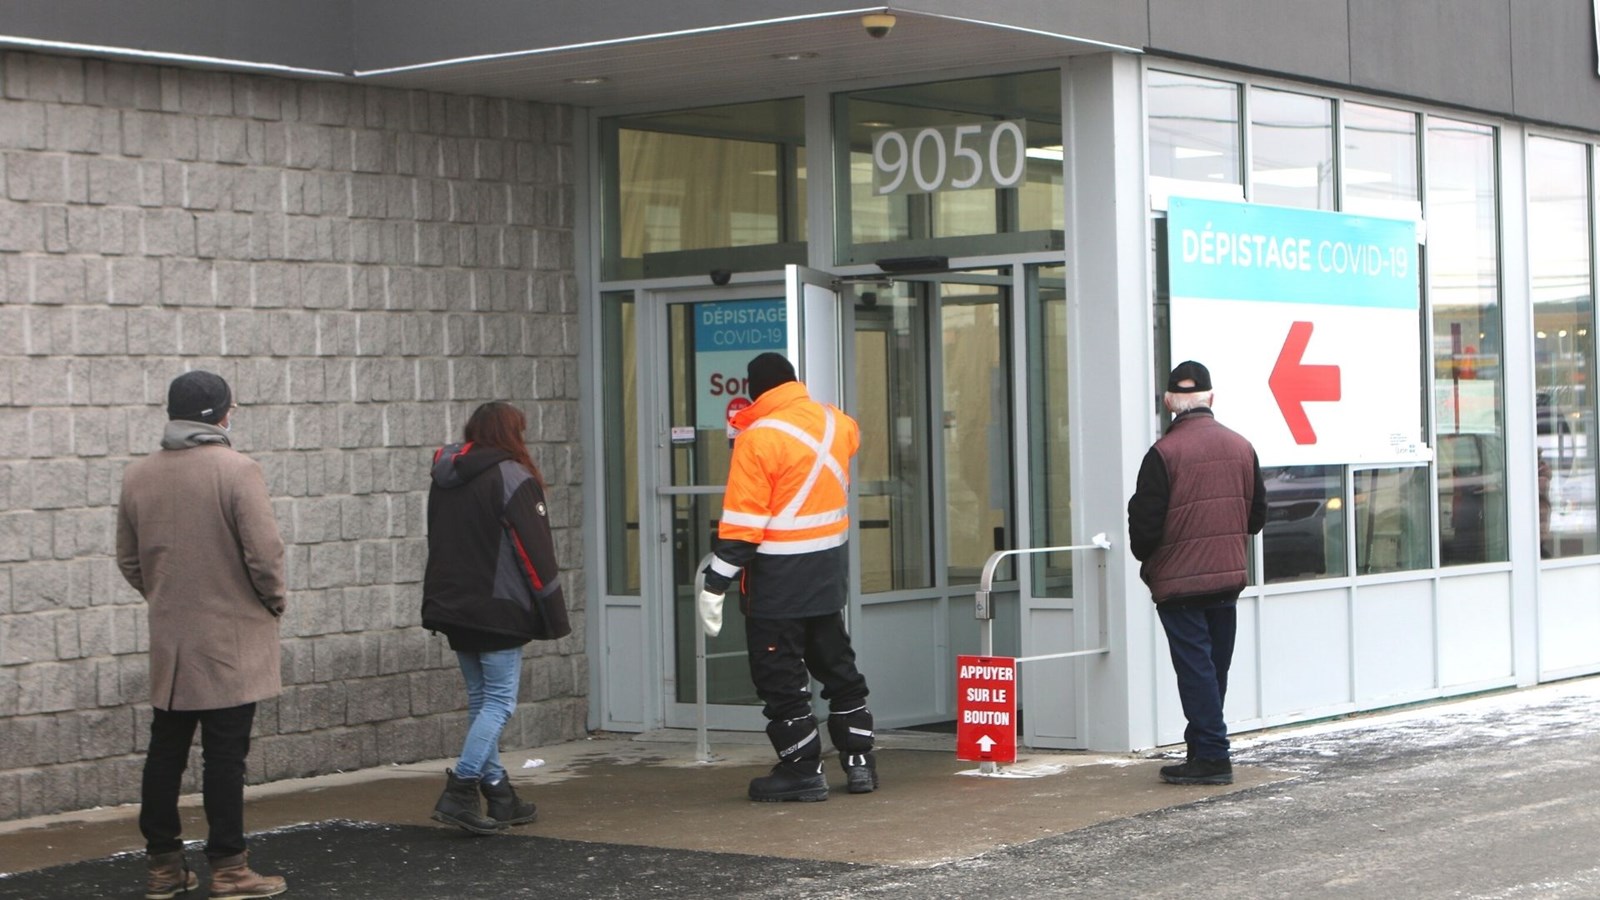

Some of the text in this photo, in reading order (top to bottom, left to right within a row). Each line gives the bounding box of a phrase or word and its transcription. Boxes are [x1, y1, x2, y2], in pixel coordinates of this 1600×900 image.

[875, 122, 1024, 194] 9050
[1182, 221, 1409, 278] DÉPISTAGE COVID-19
[703, 307, 787, 325] DÉPISTAGE
[713, 328, 783, 345] COVID-19
[960, 665, 1013, 680] APPUYER
[967, 688, 1006, 703] SUR LE
[964, 710, 1009, 725] BOUTON
